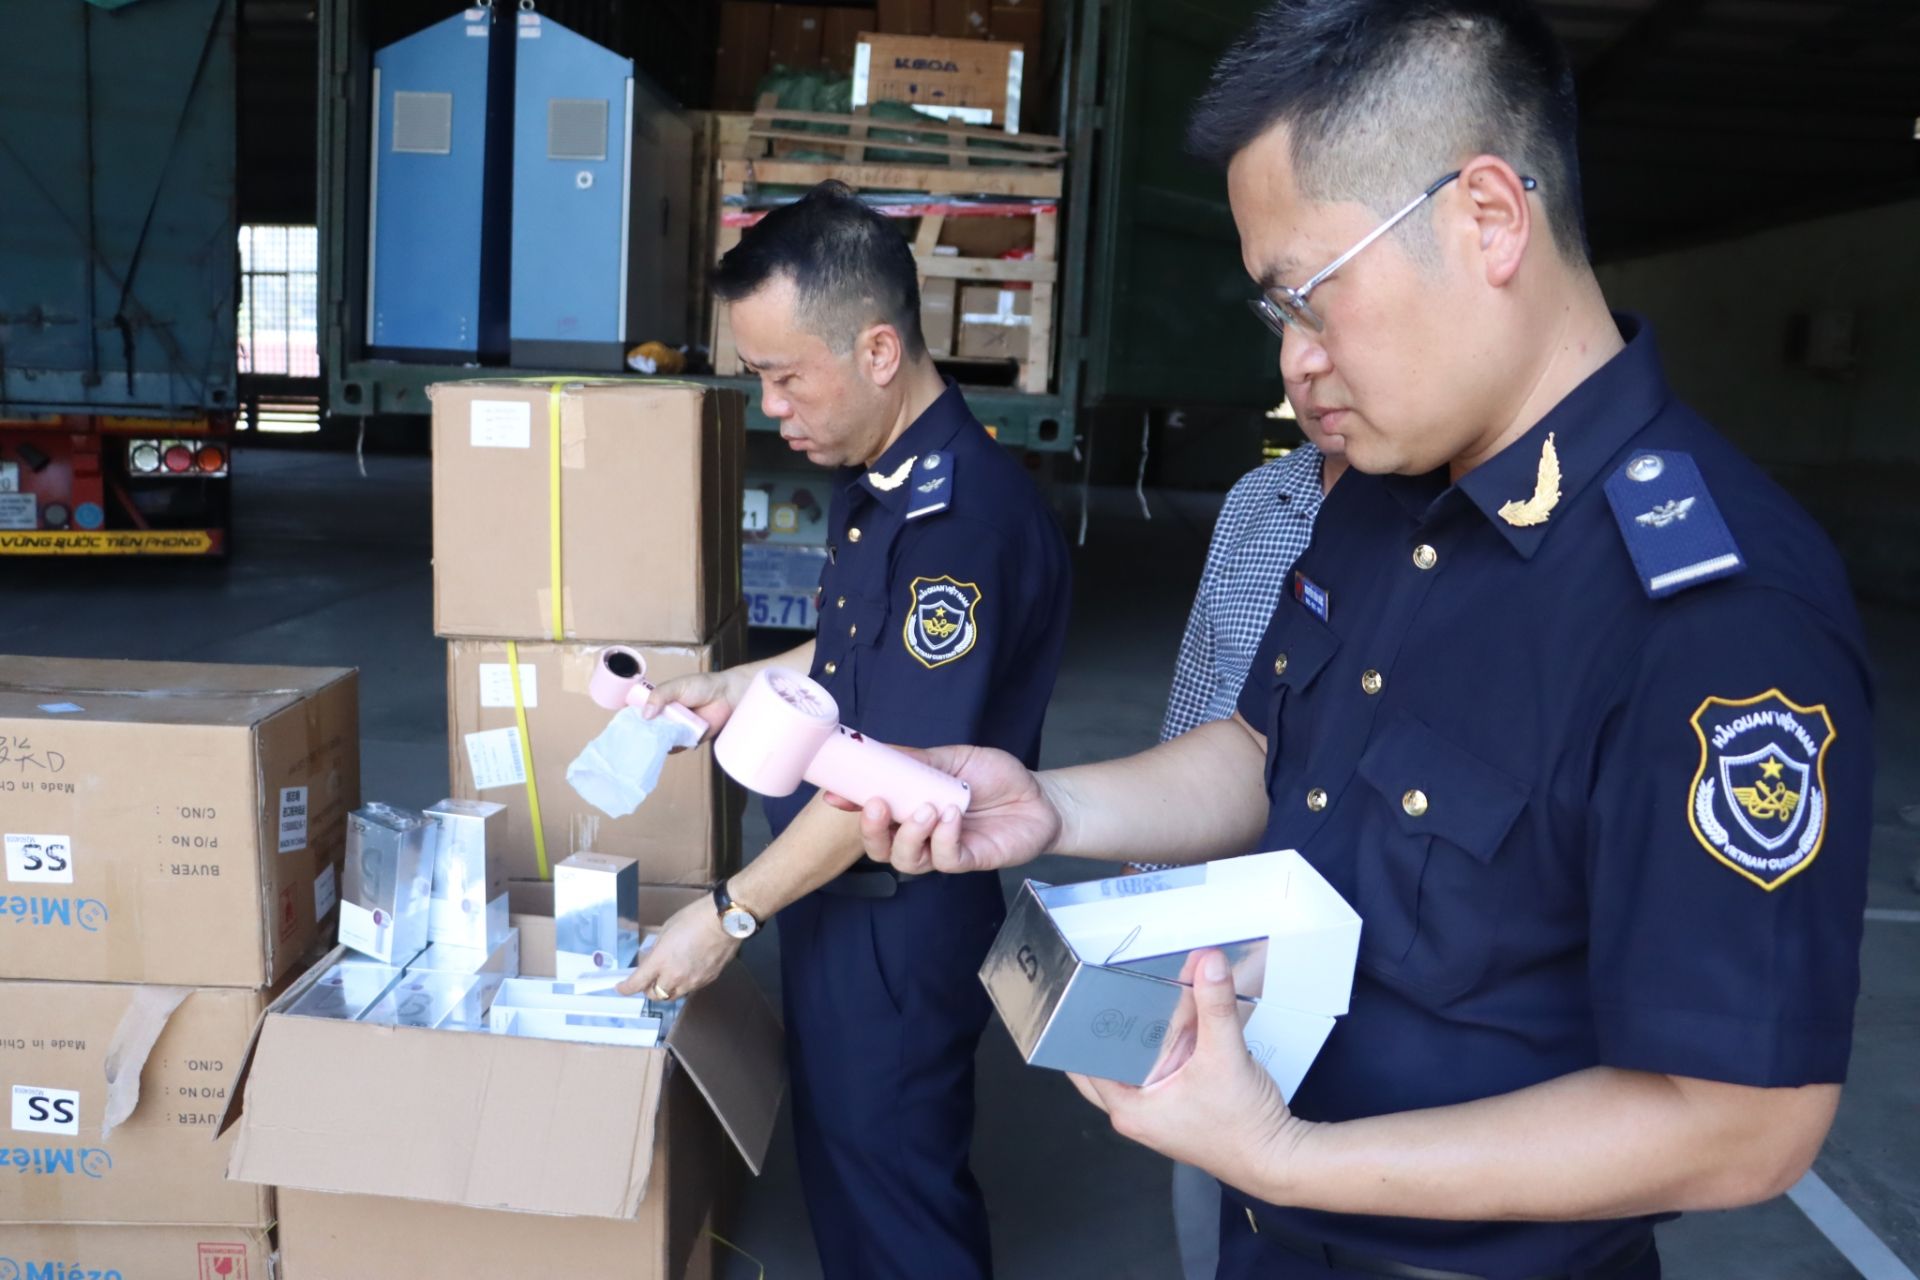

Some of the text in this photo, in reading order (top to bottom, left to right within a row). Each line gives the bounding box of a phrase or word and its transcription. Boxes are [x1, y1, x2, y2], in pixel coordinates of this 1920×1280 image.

[1712, 724, 1736, 749] HẢI
[1732, 711, 1773, 732] QUAN
[1794, 725, 1818, 758] NAM
[22, 781, 34, 792] in
[41, 782, 75, 794] Made
[171, 835, 190, 847] No
[194, 836, 218, 848] P/O
[22, 844, 67, 871] SS
[1723, 844, 1767, 870] VIETNAM
[171, 864, 220, 876] BUYER
[32, 1040, 44, 1050] in
[51, 1040, 86, 1051] Made
[179, 1087, 197, 1098] No
[201, 1087, 225, 1098] P/O
[28, 1096, 74, 1124] SS
[178, 1113, 220, 1125] UYER
